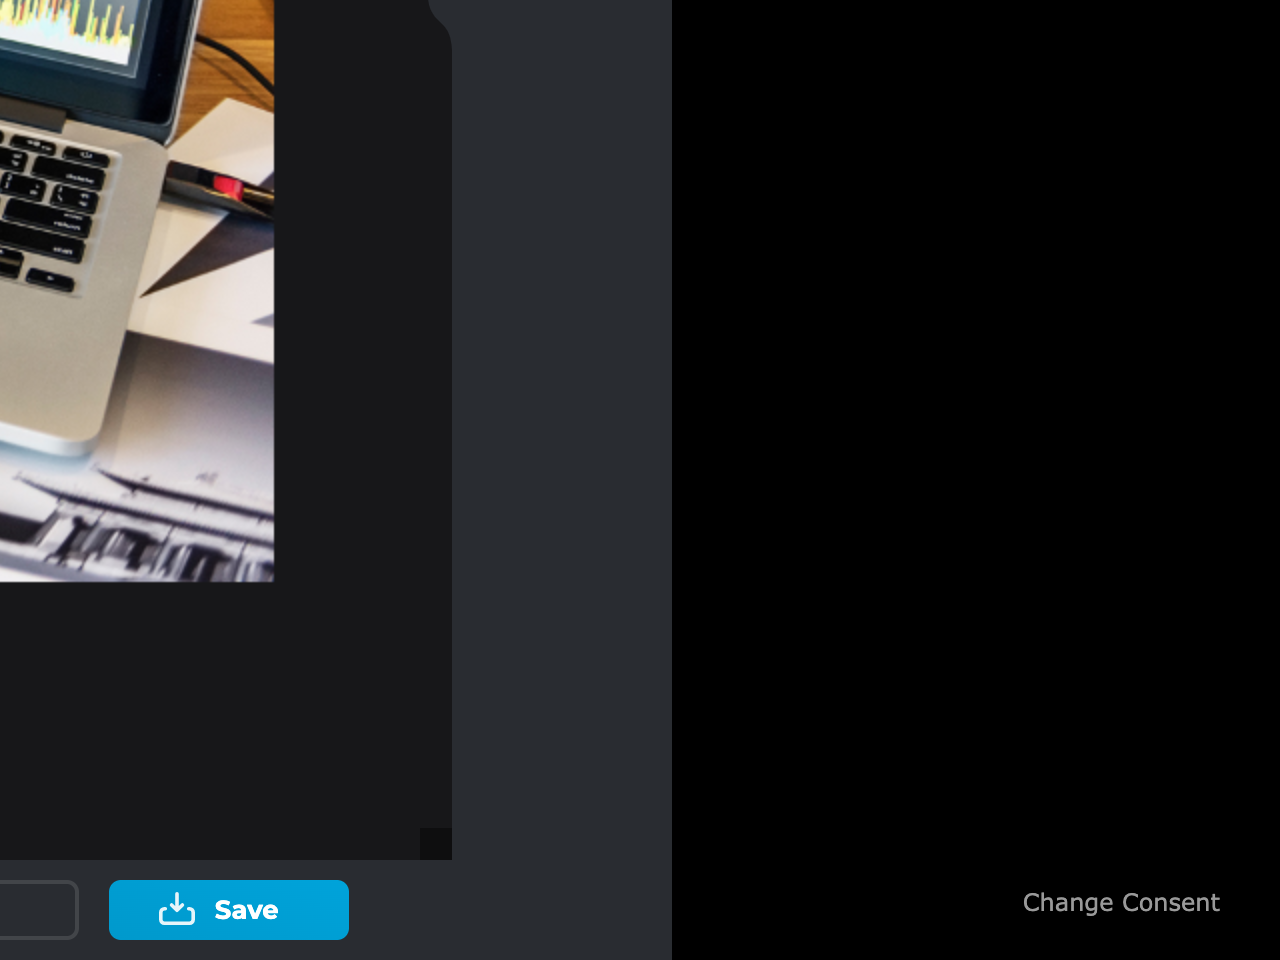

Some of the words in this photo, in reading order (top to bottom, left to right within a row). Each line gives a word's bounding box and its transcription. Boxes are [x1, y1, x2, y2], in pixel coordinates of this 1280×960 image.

[215, 900, 278, 920] Save
[1024, 892, 1113, 916] Change
[1123, 893, 1220, 912] Consent
